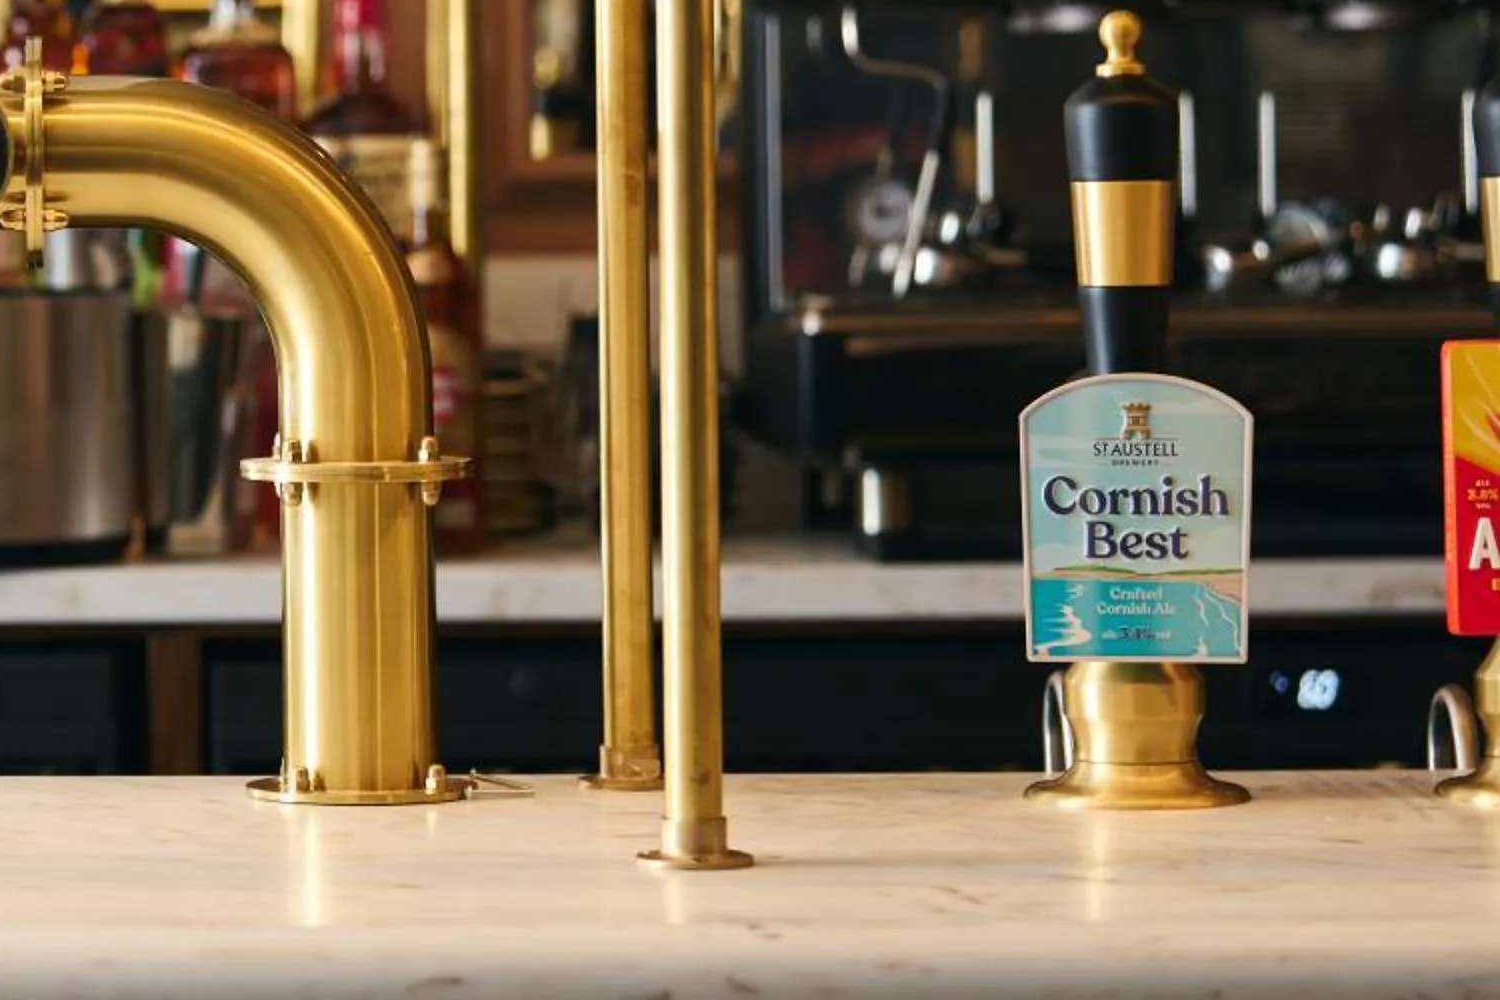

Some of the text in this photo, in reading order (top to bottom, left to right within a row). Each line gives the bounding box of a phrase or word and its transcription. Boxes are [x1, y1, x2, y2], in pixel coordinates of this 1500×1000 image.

[1111, 442, 1179, 457] AUSTELL
[1043, 474, 1229, 516] Cornish
[1085, 521, 1189, 560] Best
[1109, 586, 1163, 600] Crafted
[1096, 601, 1151, 616] Cornish
